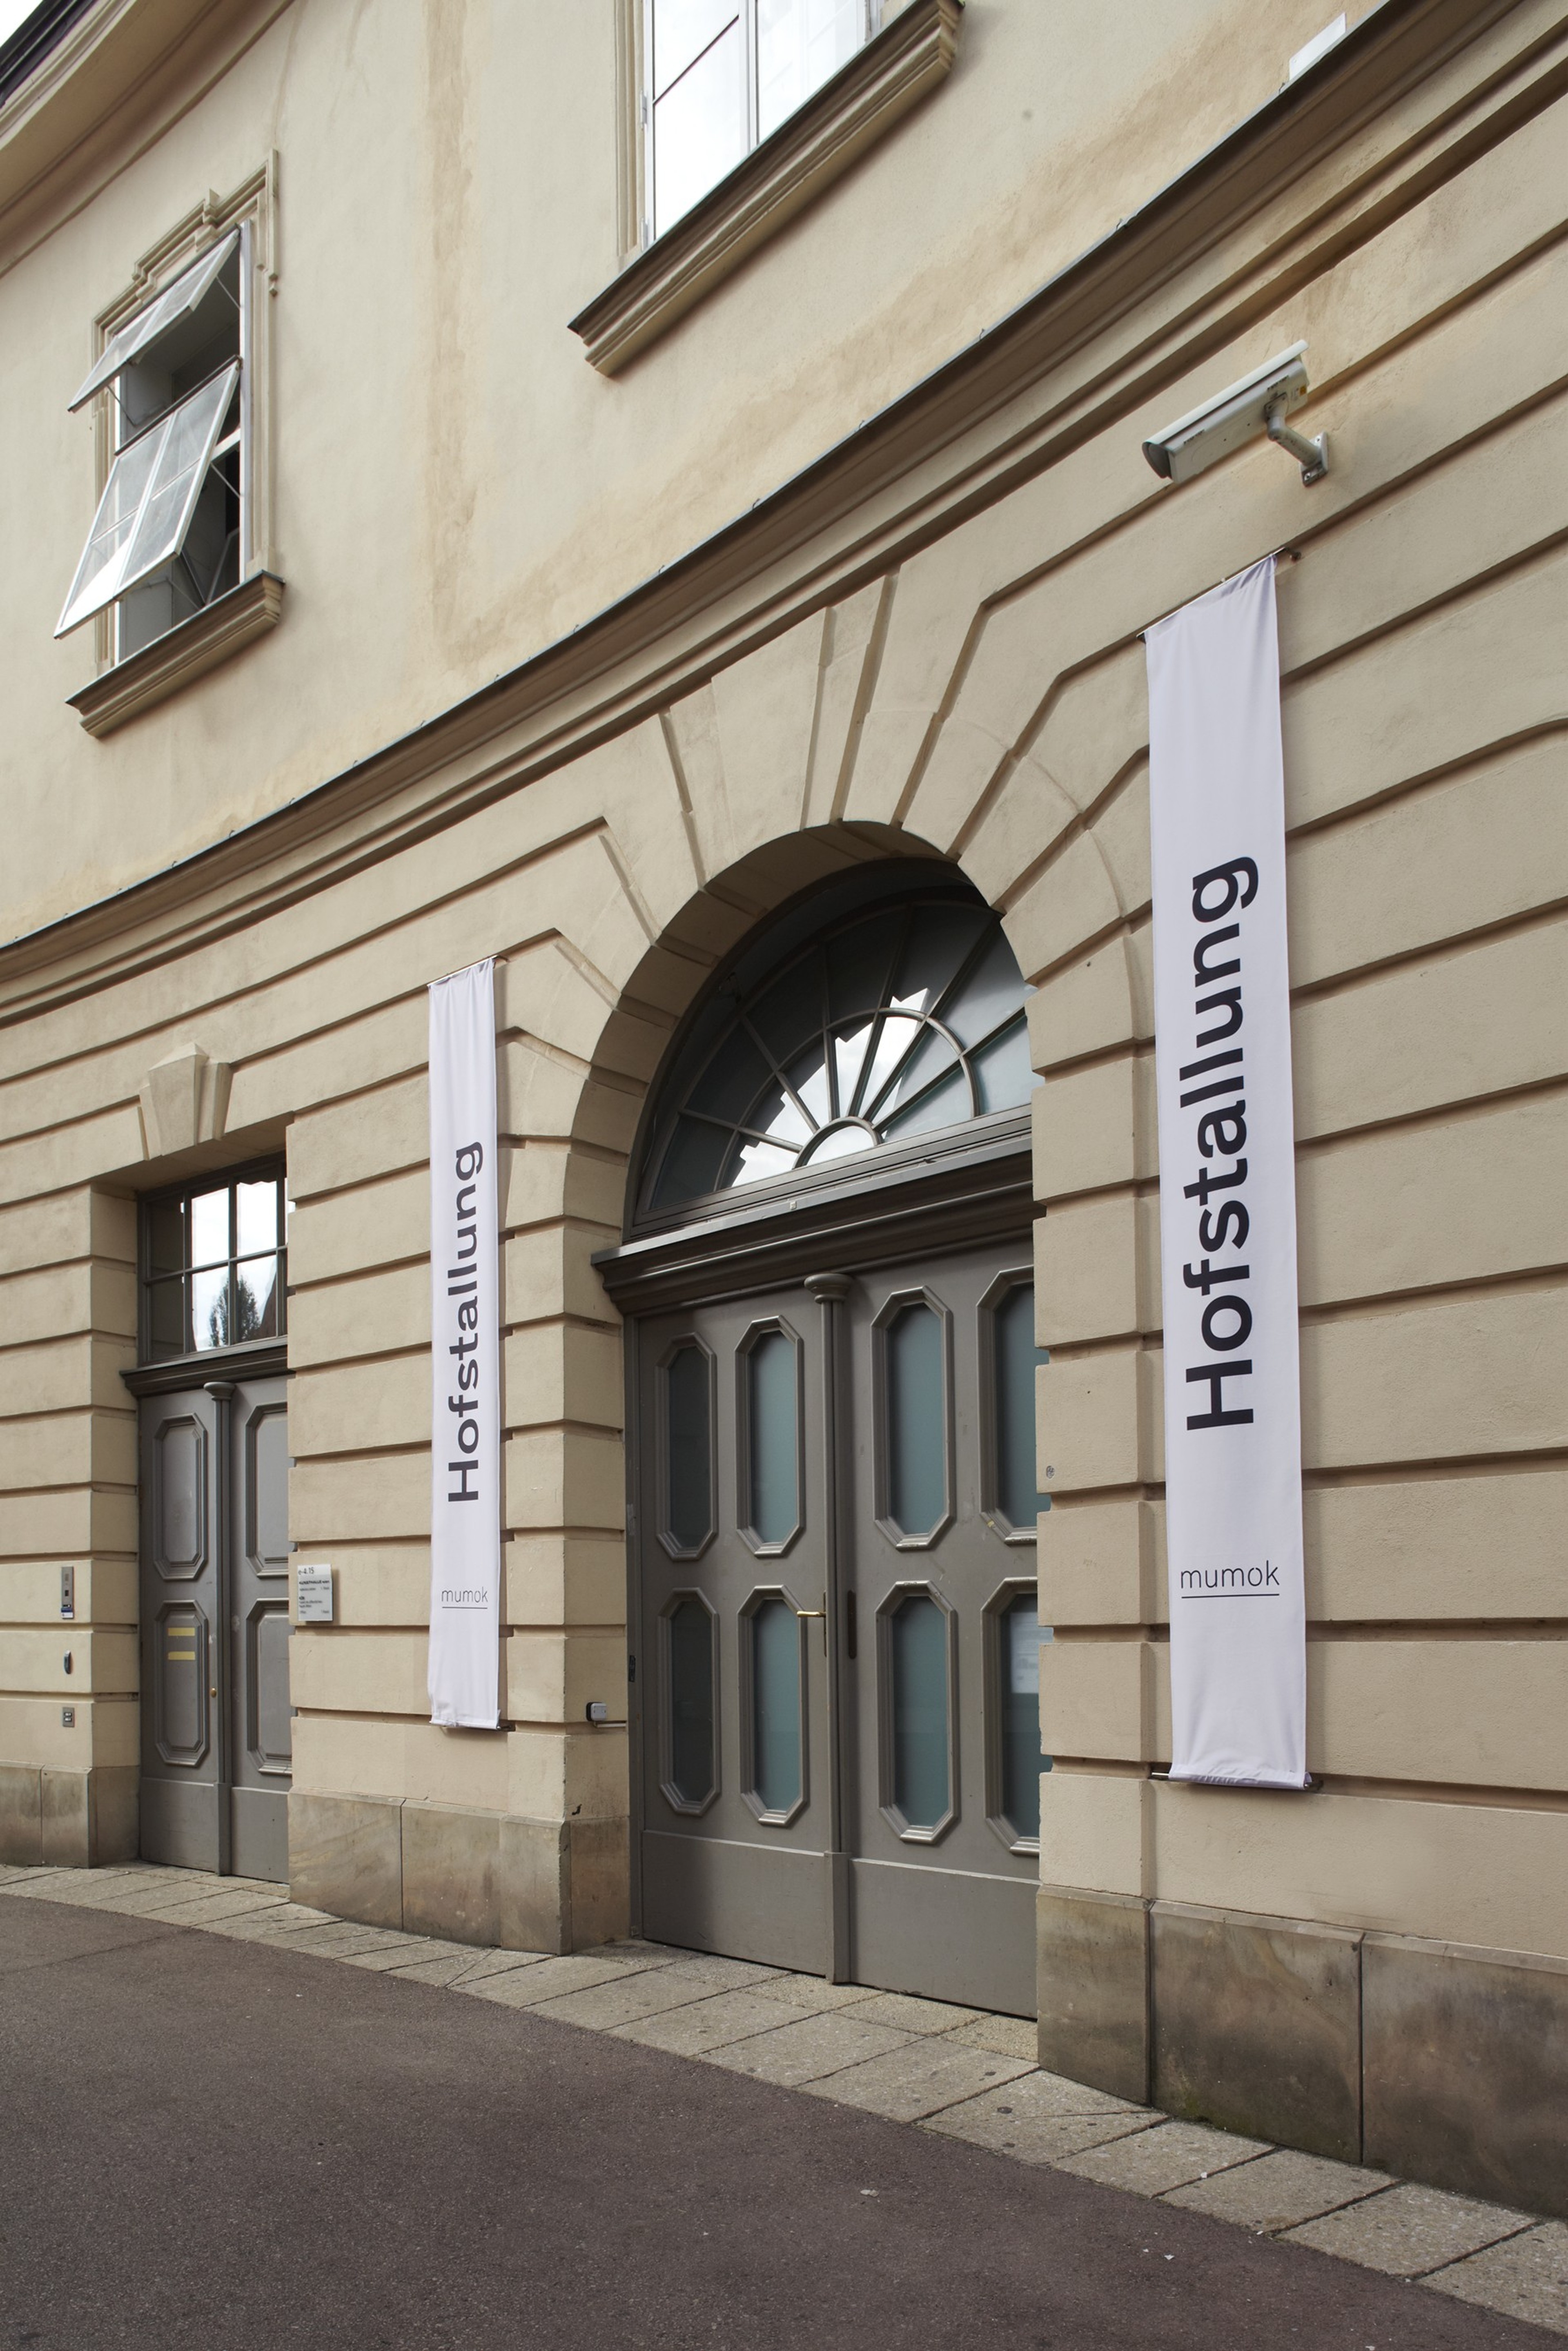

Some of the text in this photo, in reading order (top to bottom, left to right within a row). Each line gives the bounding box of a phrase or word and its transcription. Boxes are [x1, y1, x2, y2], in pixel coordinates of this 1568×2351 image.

[1179, 856, 1258, 1431] Hofstallung
[448, 1141, 483, 1502] Hofstallung
[442, 1587, 487, 1602] mumok
[1181, 1560, 1280, 1589] mumok
